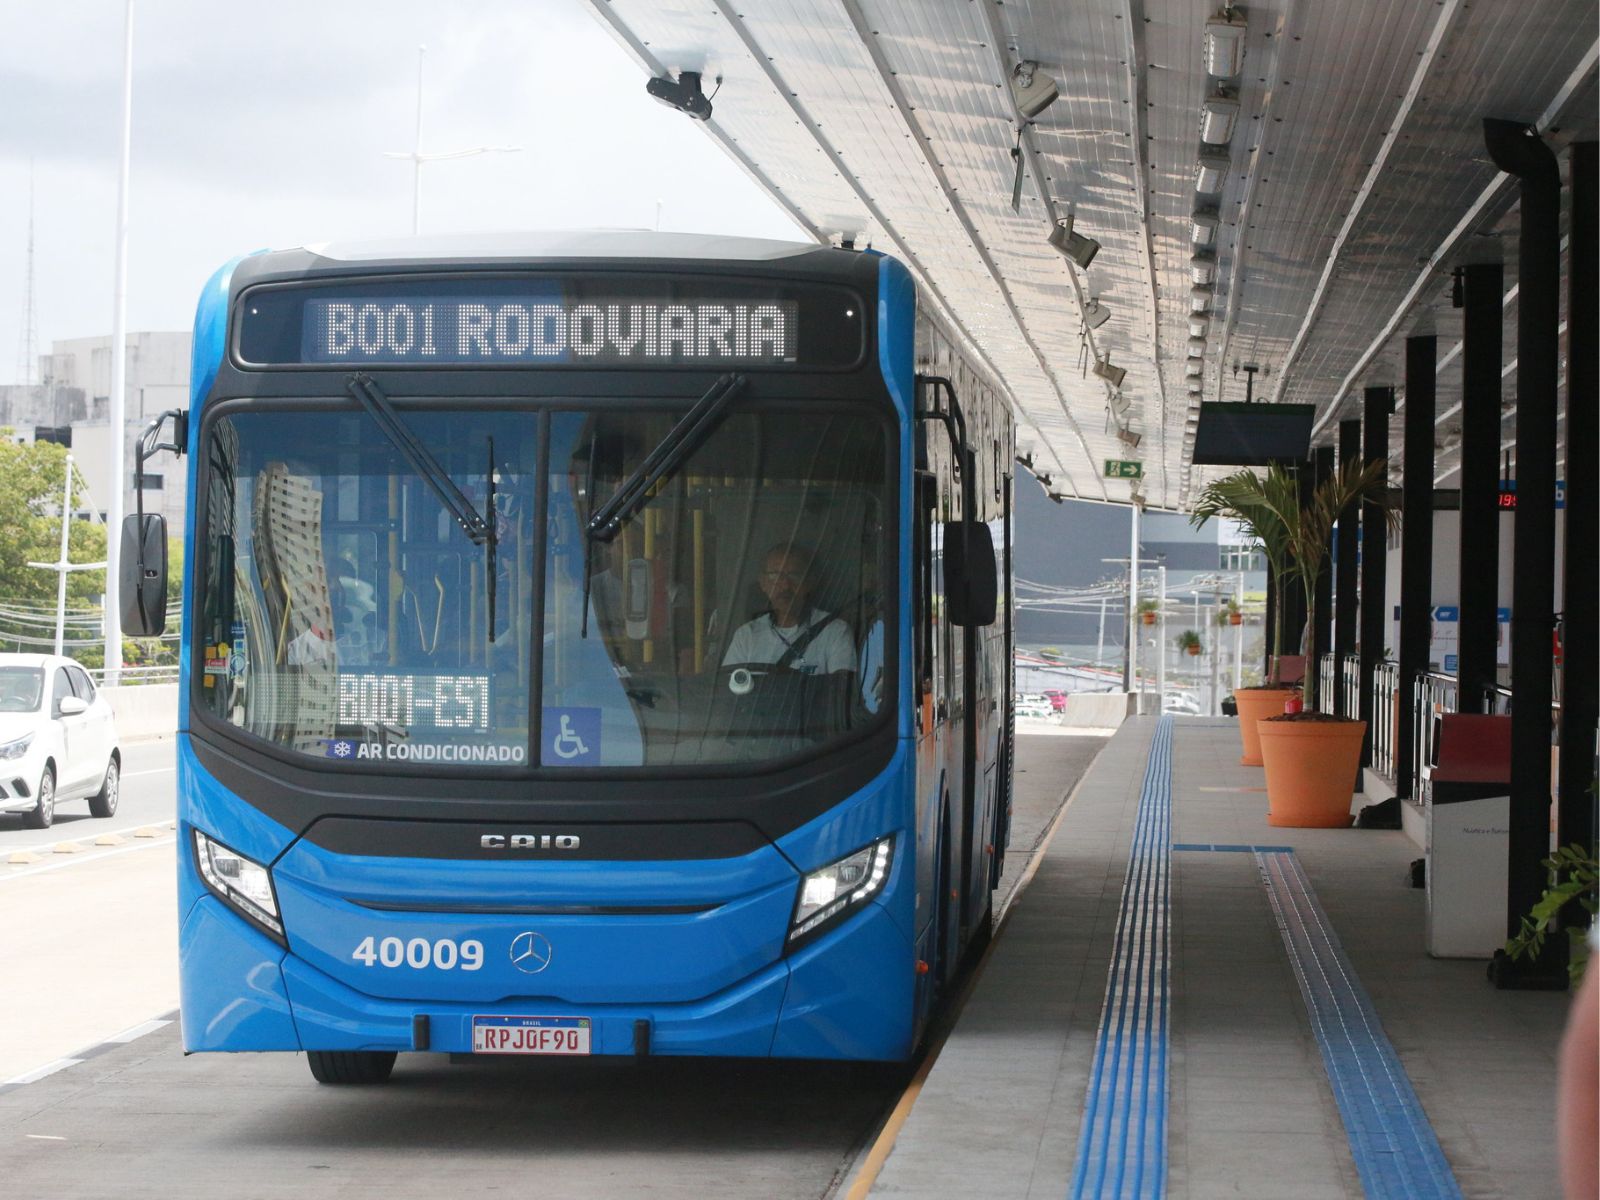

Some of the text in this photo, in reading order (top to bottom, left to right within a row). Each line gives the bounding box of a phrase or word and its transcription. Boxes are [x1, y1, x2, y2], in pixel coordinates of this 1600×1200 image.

[328, 304, 786, 357] B001 RODOVIARIA
[357, 743, 525, 762] AR CONDICIONADO
[480, 834, 581, 849] CAIO
[352, 936, 485, 971] 40009
